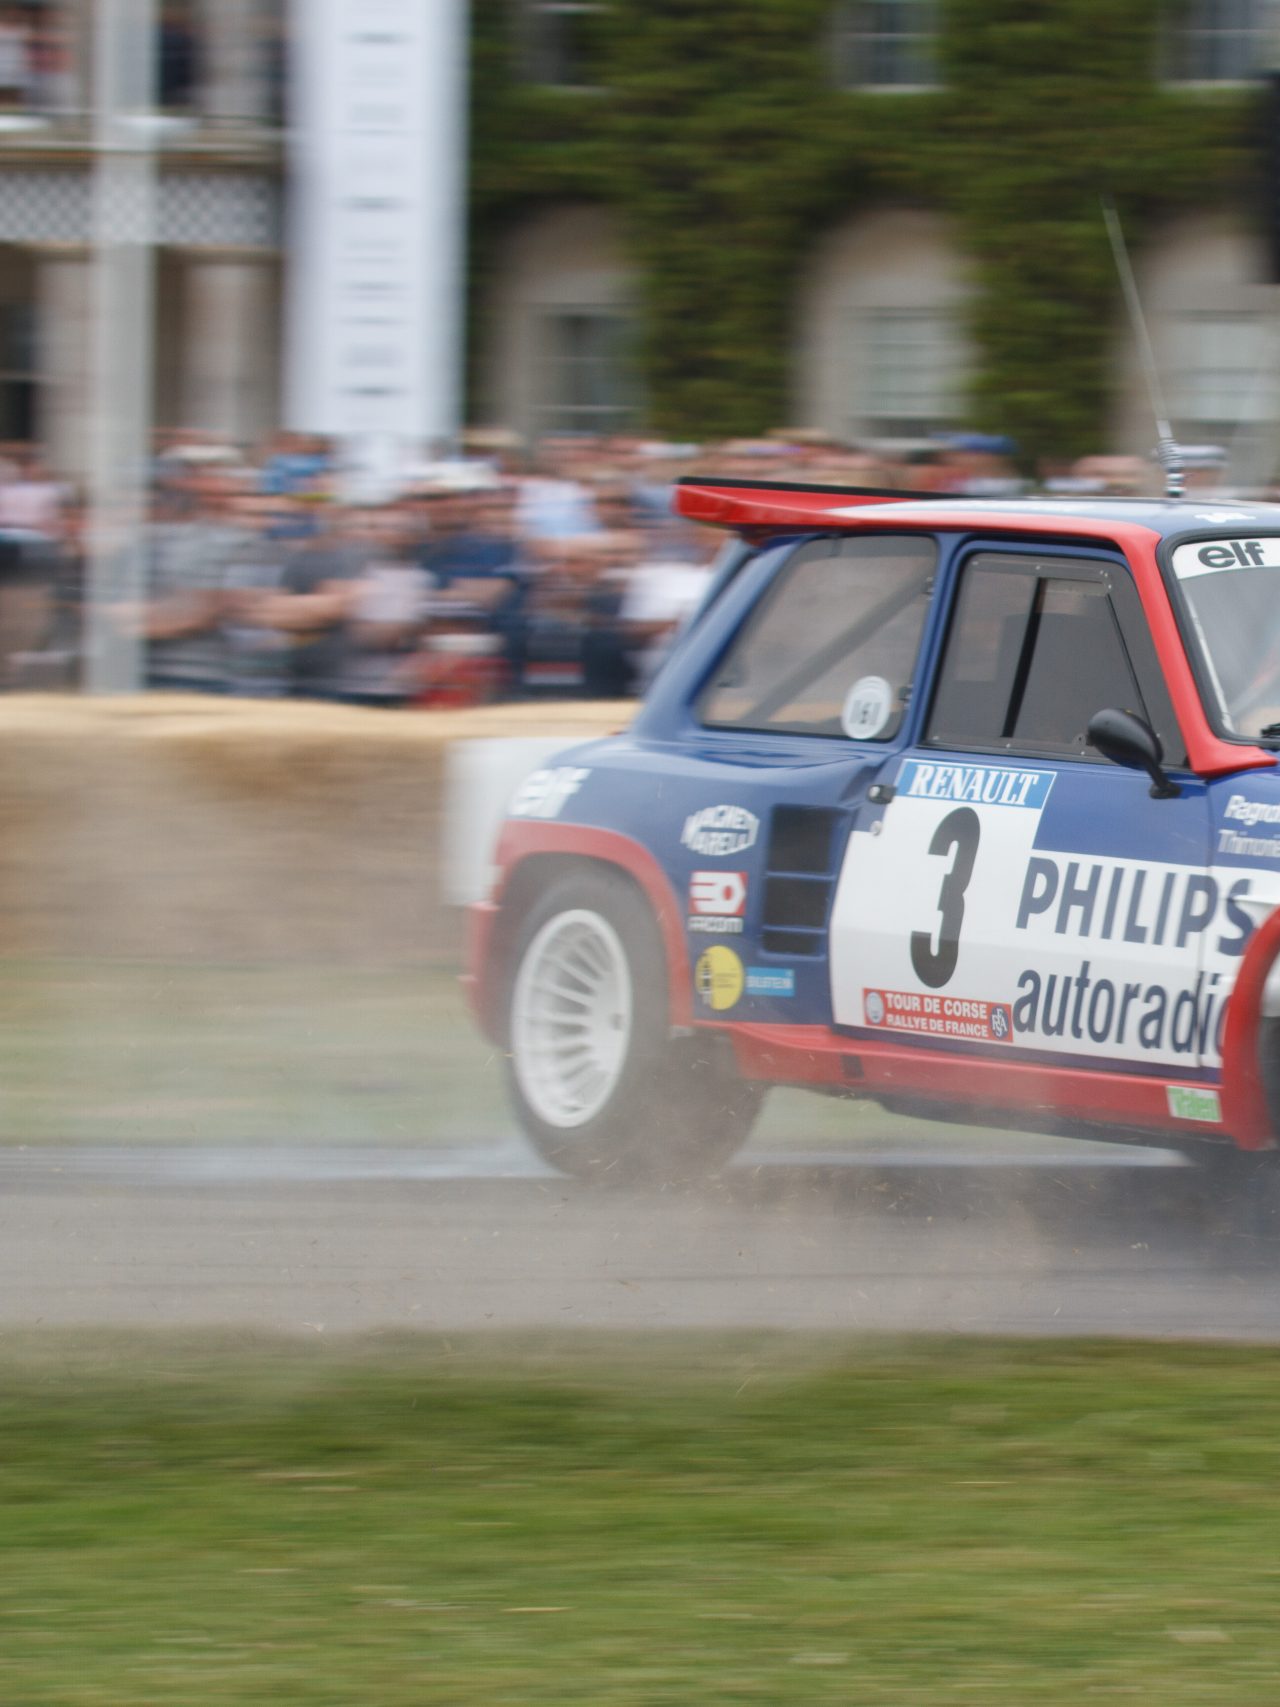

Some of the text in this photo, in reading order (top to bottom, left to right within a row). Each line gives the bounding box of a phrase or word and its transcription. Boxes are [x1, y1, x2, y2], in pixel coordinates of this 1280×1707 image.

[1198, 541, 1264, 567] elf
[908, 765, 1039, 805] RENAULT
[910, 806, 980, 989] 3
[1016, 856, 1256, 957] PHILIPS
[884, 993, 988, 1019] TOUR DE CORSE
[886, 1014, 988, 1037] RALLYE DE FRANCE
